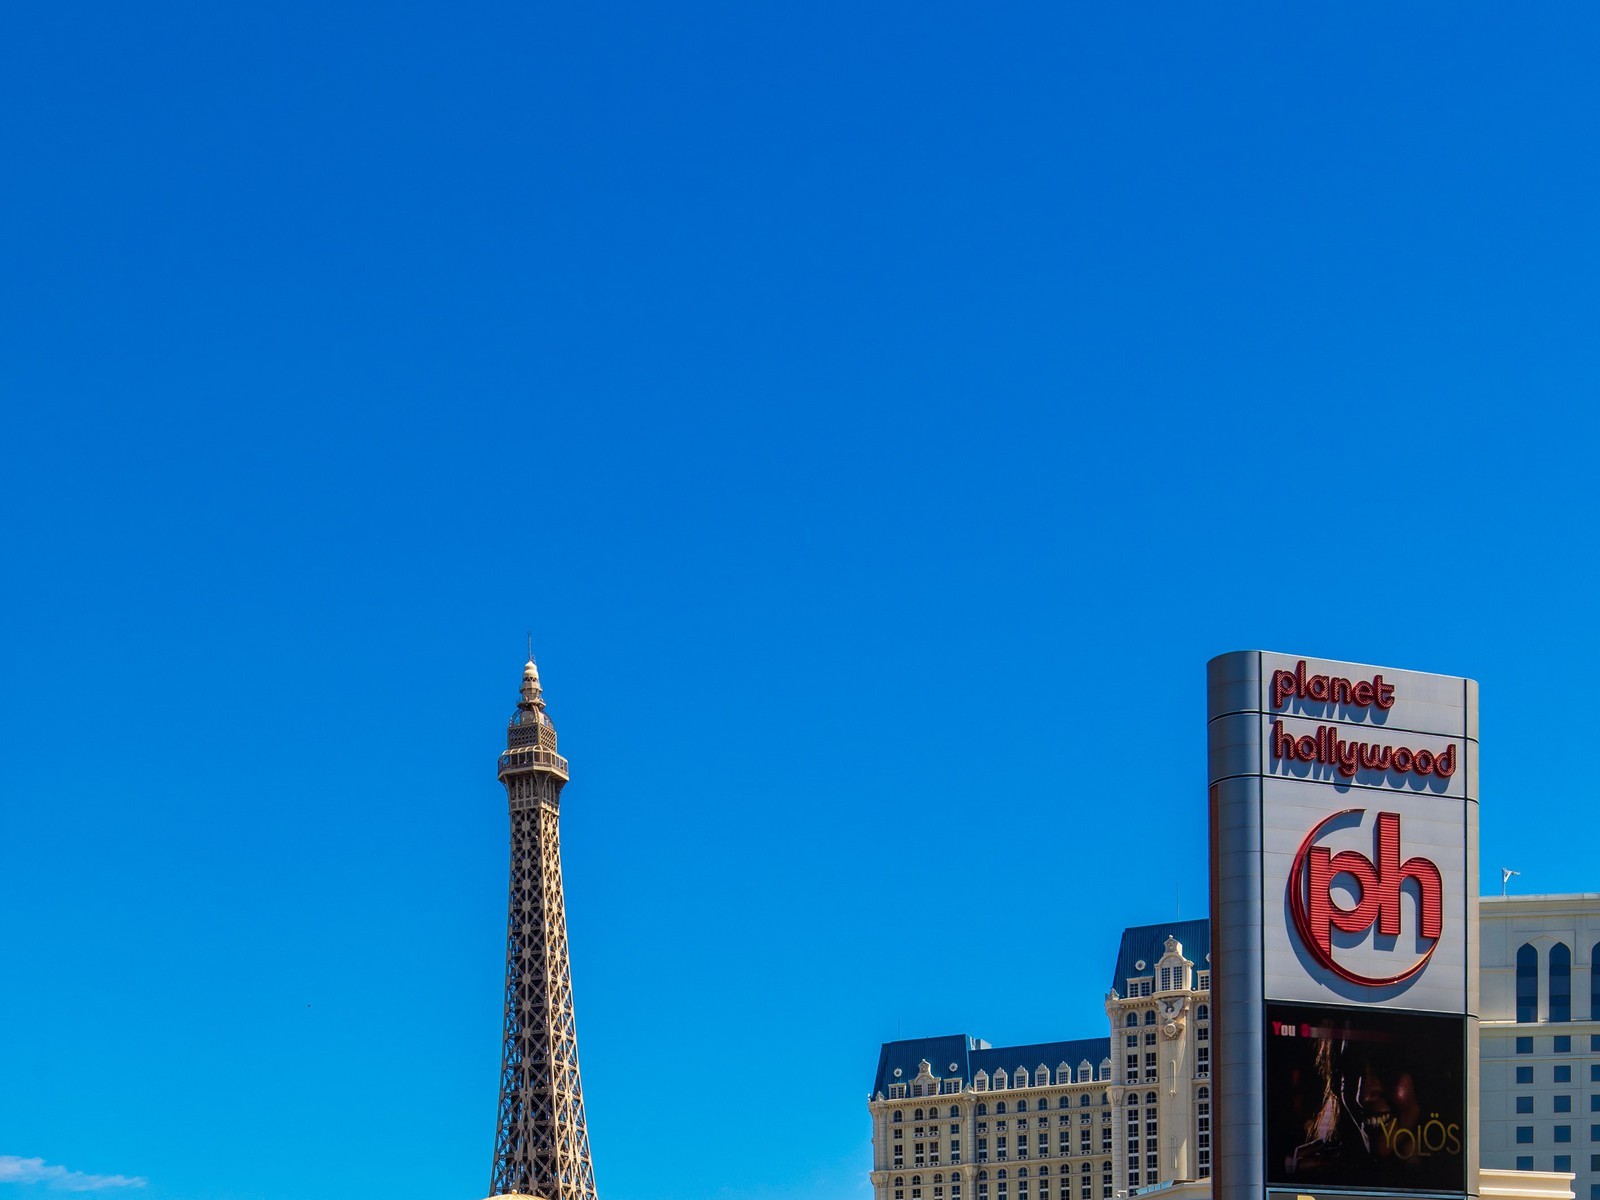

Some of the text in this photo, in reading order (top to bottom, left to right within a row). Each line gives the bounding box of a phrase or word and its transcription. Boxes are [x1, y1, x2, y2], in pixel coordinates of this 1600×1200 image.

[1273, 660, 1396, 709] planet
[1274, 720, 1457, 777] hollywood
[1307, 811, 1443, 966] ph
[1380, 1112, 1461, 1160] YOLÖS
